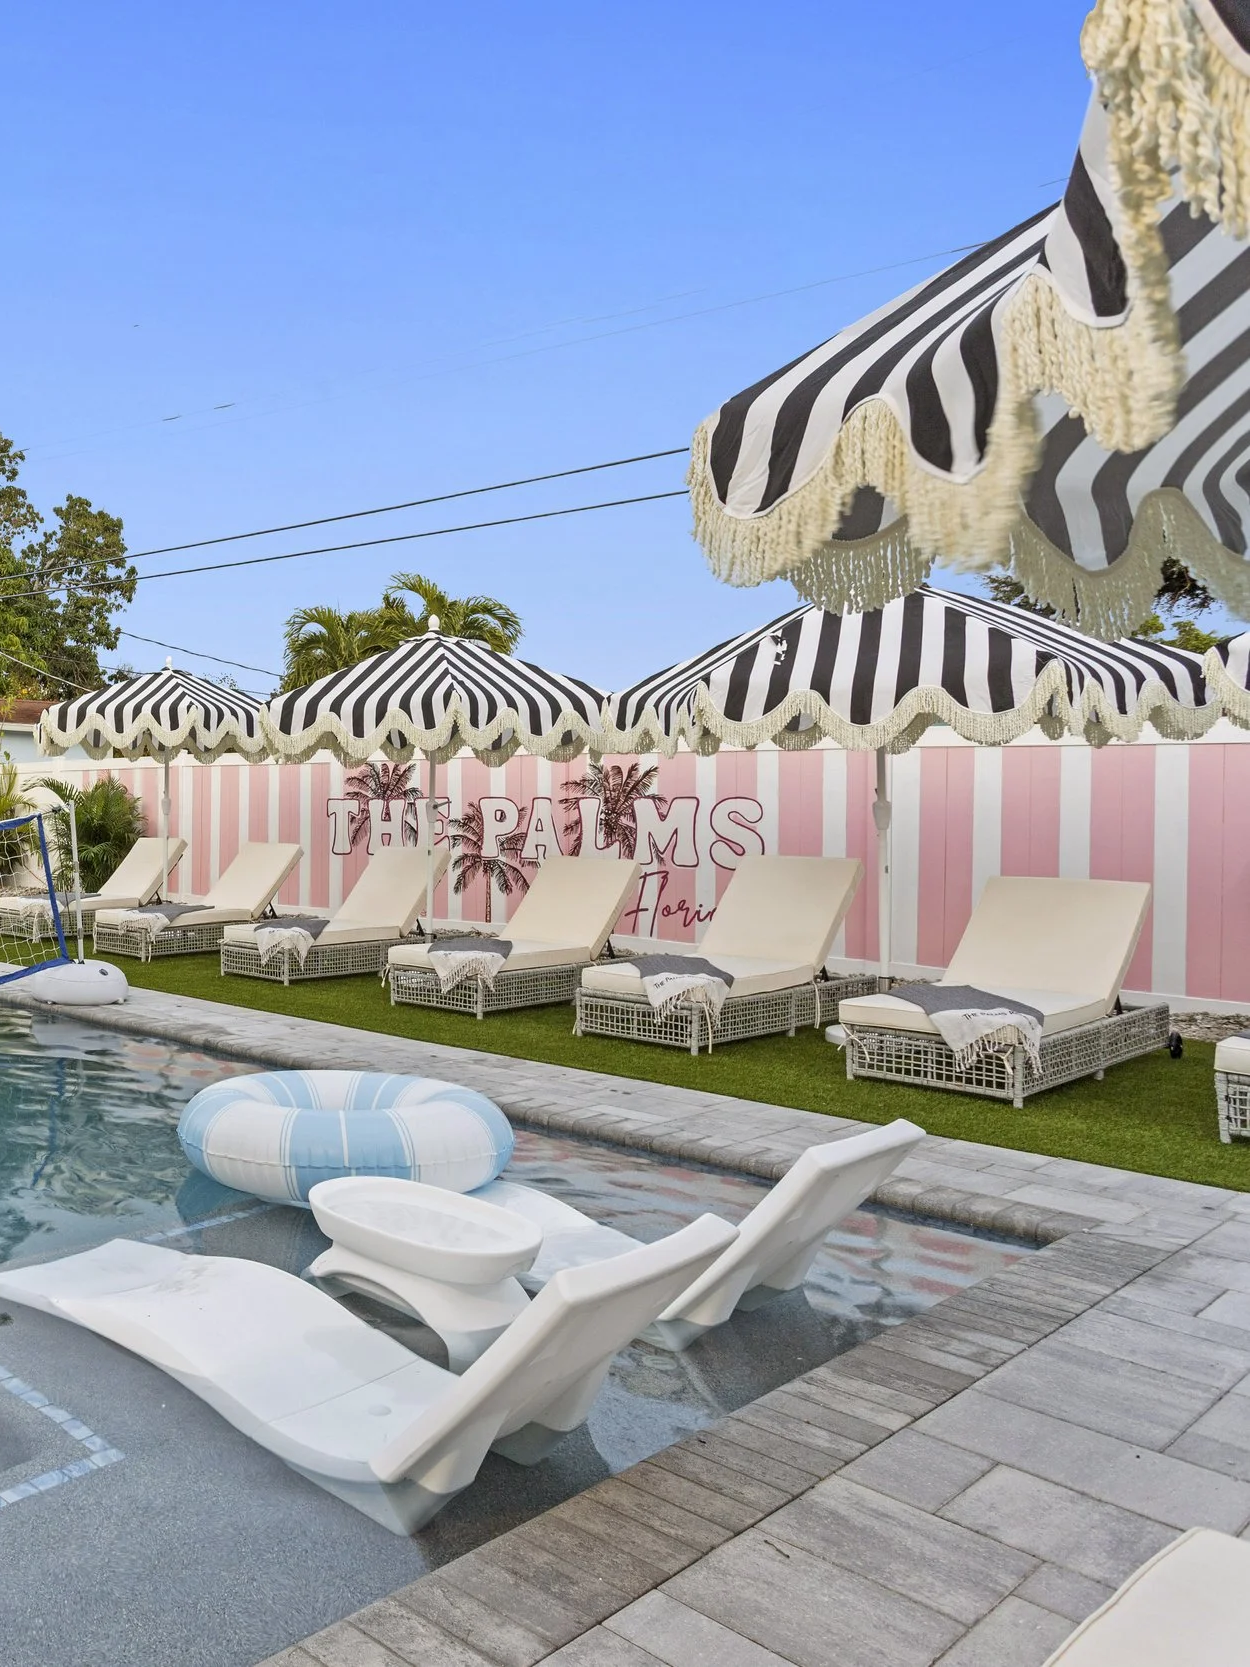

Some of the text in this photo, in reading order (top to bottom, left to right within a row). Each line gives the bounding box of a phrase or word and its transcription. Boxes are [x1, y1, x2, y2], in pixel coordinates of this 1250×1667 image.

[326, 796, 766, 871] THE PALMS
[624, 870, 718, 938] Flori
